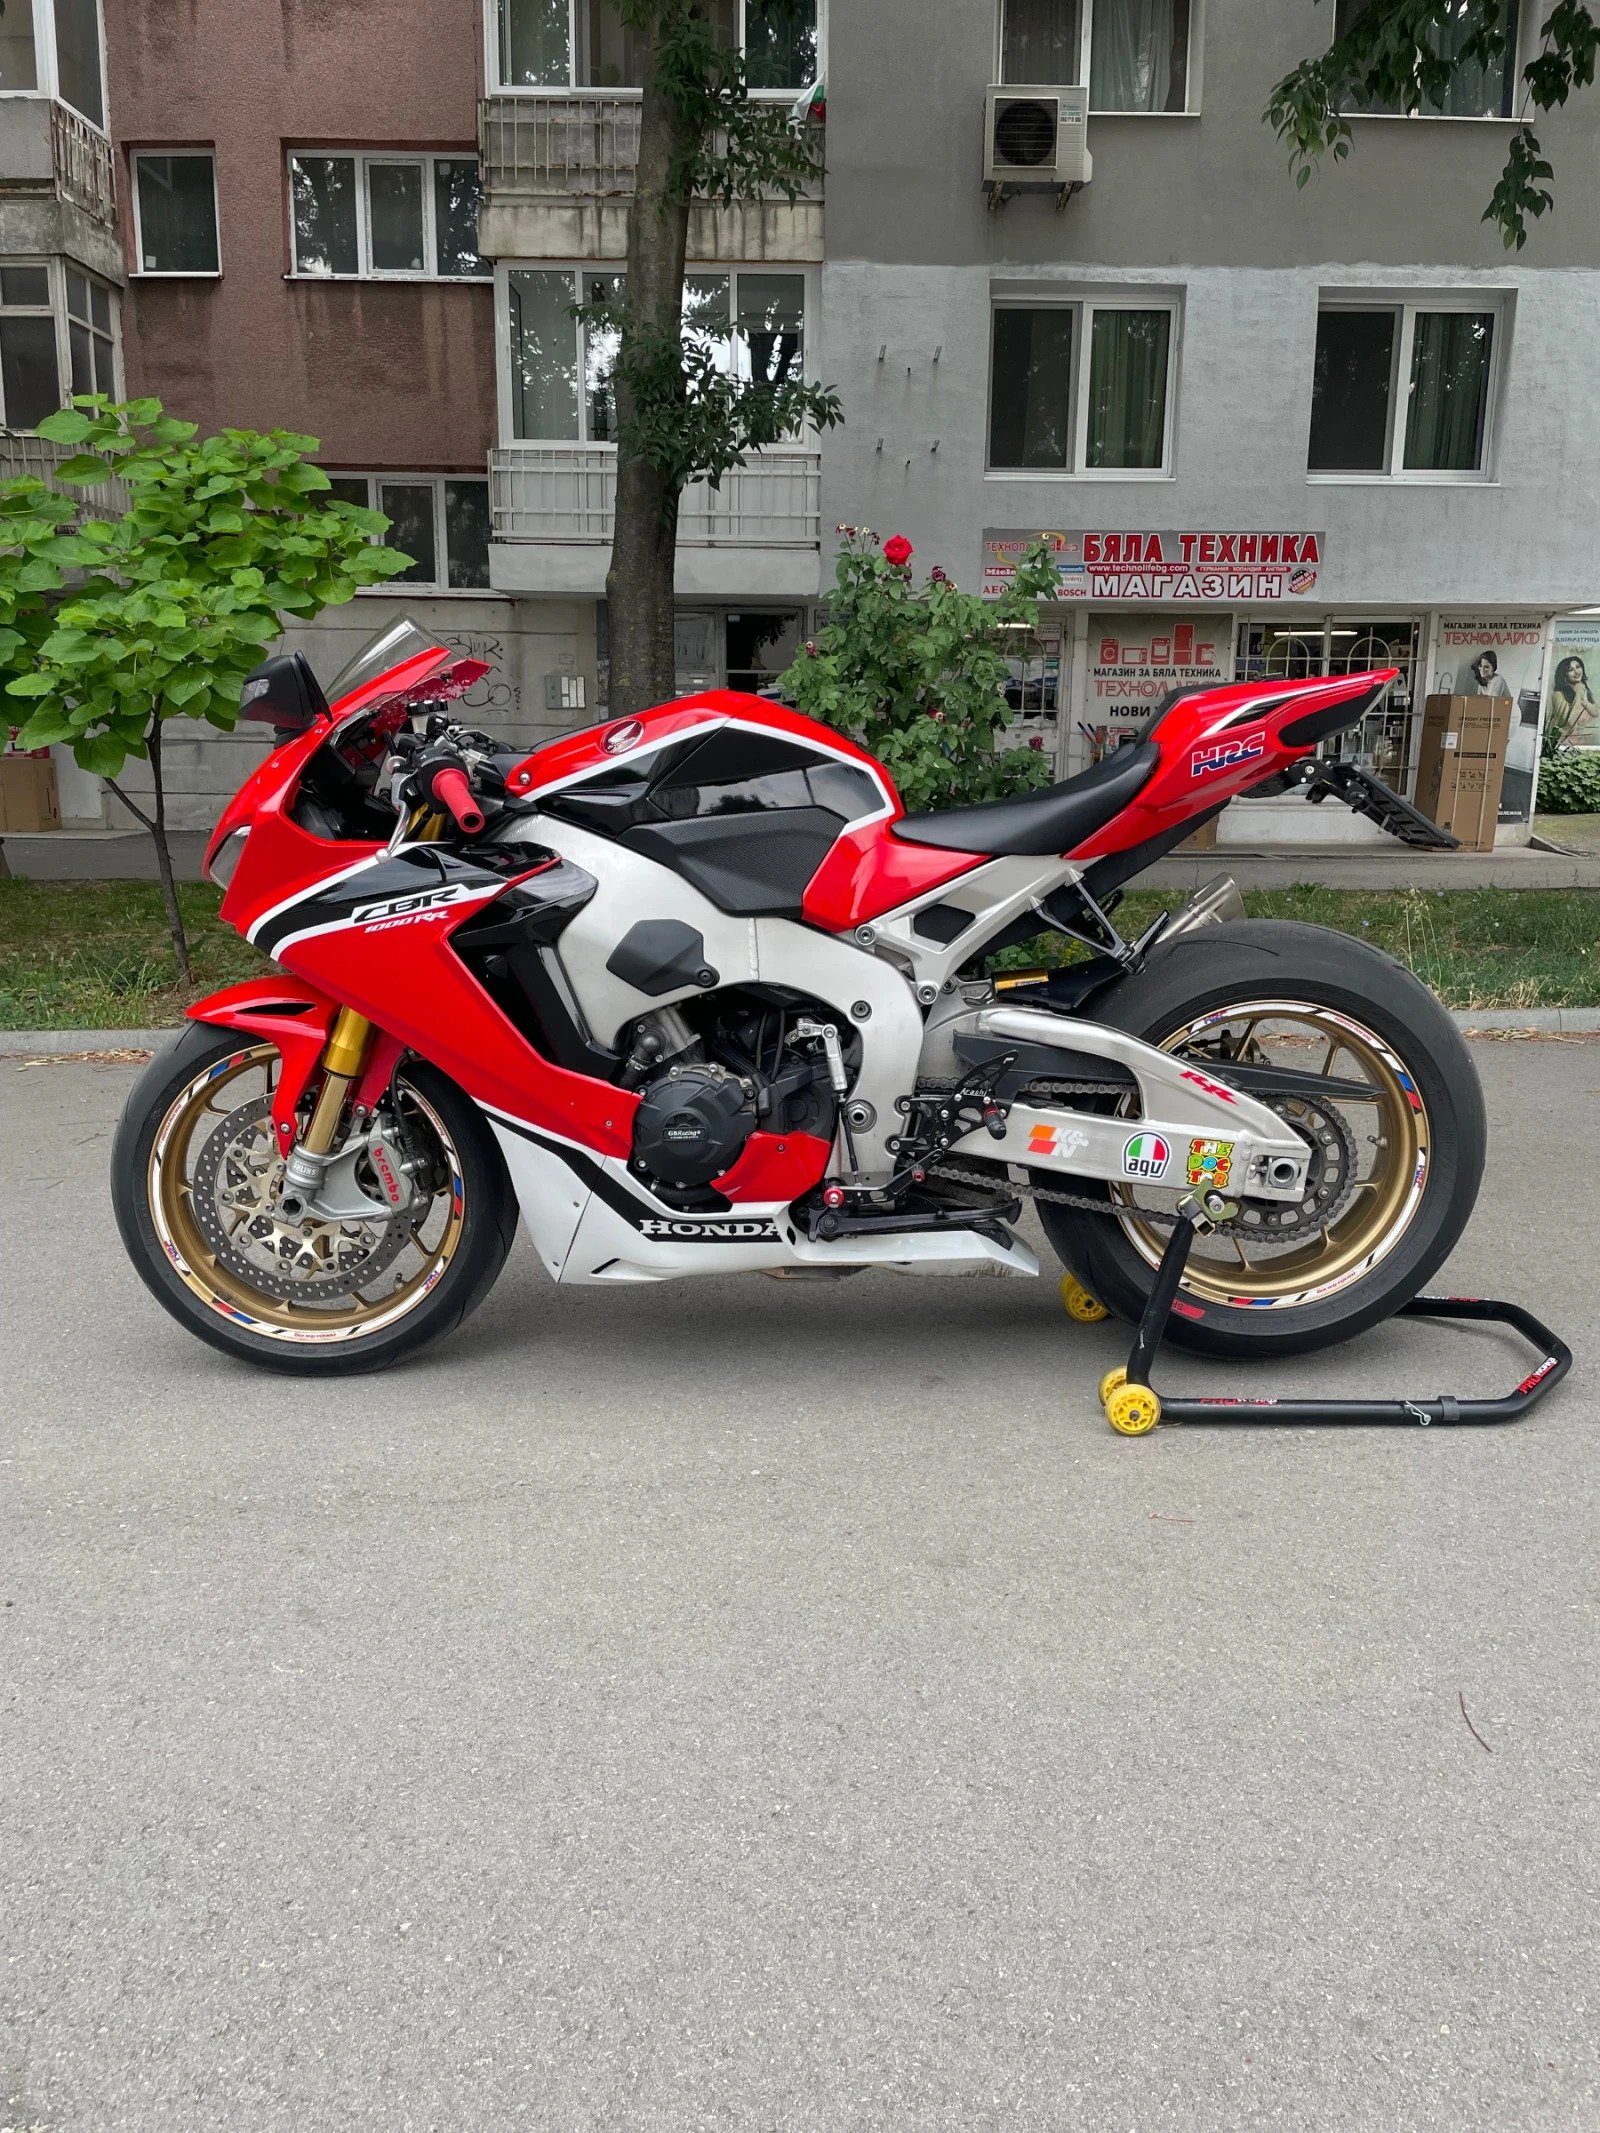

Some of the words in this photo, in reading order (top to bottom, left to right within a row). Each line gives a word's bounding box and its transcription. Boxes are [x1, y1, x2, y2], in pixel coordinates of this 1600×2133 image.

[1084, 534, 1164, 563] БЯЛА
[1179, 534, 1320, 564] ТЕХНИКА
[985, 568, 1017, 576] Miele
[1088, 564, 1188, 573] www.technolifebg.com
[983, 586, 1007, 594] AEG
[1057, 589, 1087, 597] BOSCH
[1092, 574, 1282, 598] МАГАЗИН
[1444, 622, 1477, 630] МАГАЗИН
[1509, 622, 1541, 630] ТЕХНИКА
[1094, 668, 1136, 677] МАГАЗИН
[1138, 668, 1150, 677] ЗА
[1153, 668, 1177, 677] БЯЛА
[1180, 668, 1221, 677] ТЕХНИКА
[1110, 706, 1150, 717] НОВИ
[1191, 731, 1265, 777] HRC
[354, 887, 460, 923] CBR
[1193, 1141, 1231, 1156] THE
[1128, 1158, 1162, 1177] agv
[1189, 1155, 1229, 1172] DOC
[373, 1147, 399, 1202] brembo
[639, 1219, 780, 1236] HONDA
